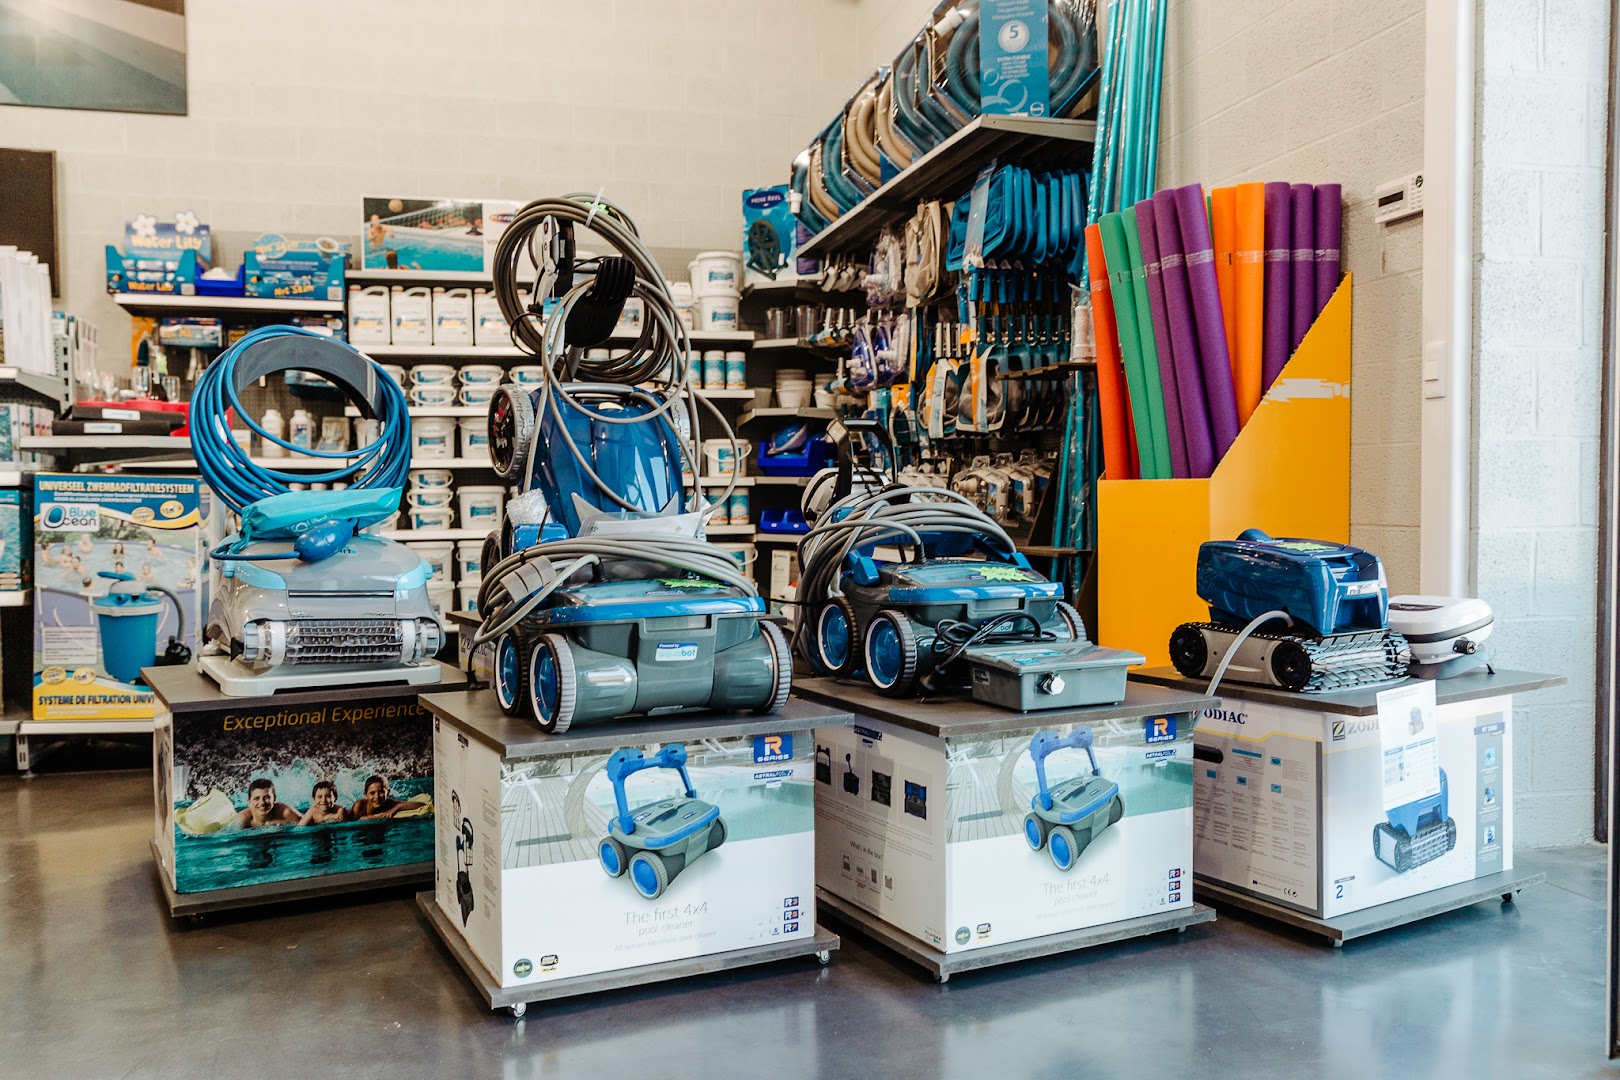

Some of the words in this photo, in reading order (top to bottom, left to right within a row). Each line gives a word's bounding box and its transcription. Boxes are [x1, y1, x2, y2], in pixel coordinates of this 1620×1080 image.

[1009, 25, 1019, 39] 5
[131, 234, 173, 248] Water
[175, 234, 203, 250] Lily
[128, 281, 156, 291] Water
[39, 481, 85, 492] UNIVERSEEL
[87, 482, 195, 494] ZWEMBADFILTRATIESYSTEEM
[44, 505, 97, 528] Ocean
[69, 507, 97, 518] Blue
[659, 649, 696, 658] aquabot
[39, 695, 74, 706] SYSTEME
[75, 695, 87, 705] DE
[88, 694, 131, 705] FILTRATION
[223, 708, 327, 730] Exceptional
[331, 703, 425, 724] Experience
[1153, 718, 1168, 736] R
[1147, 734, 1174, 743] SERIES
[764, 736, 783, 756] R
[757, 754, 790, 763] SERIES
[1042, 882, 1064, 896] The
[1067, 878, 1087, 892] first
[1090, 873, 1110, 886] 4x4
[1336, 885, 1344, 899] 2
[624, 911, 649, 925] The
[654, 906, 680, 921] first
[683, 901, 708, 915] 4x4
[638, 924, 659, 937] pool
[660, 921, 694, 931] cleaner
